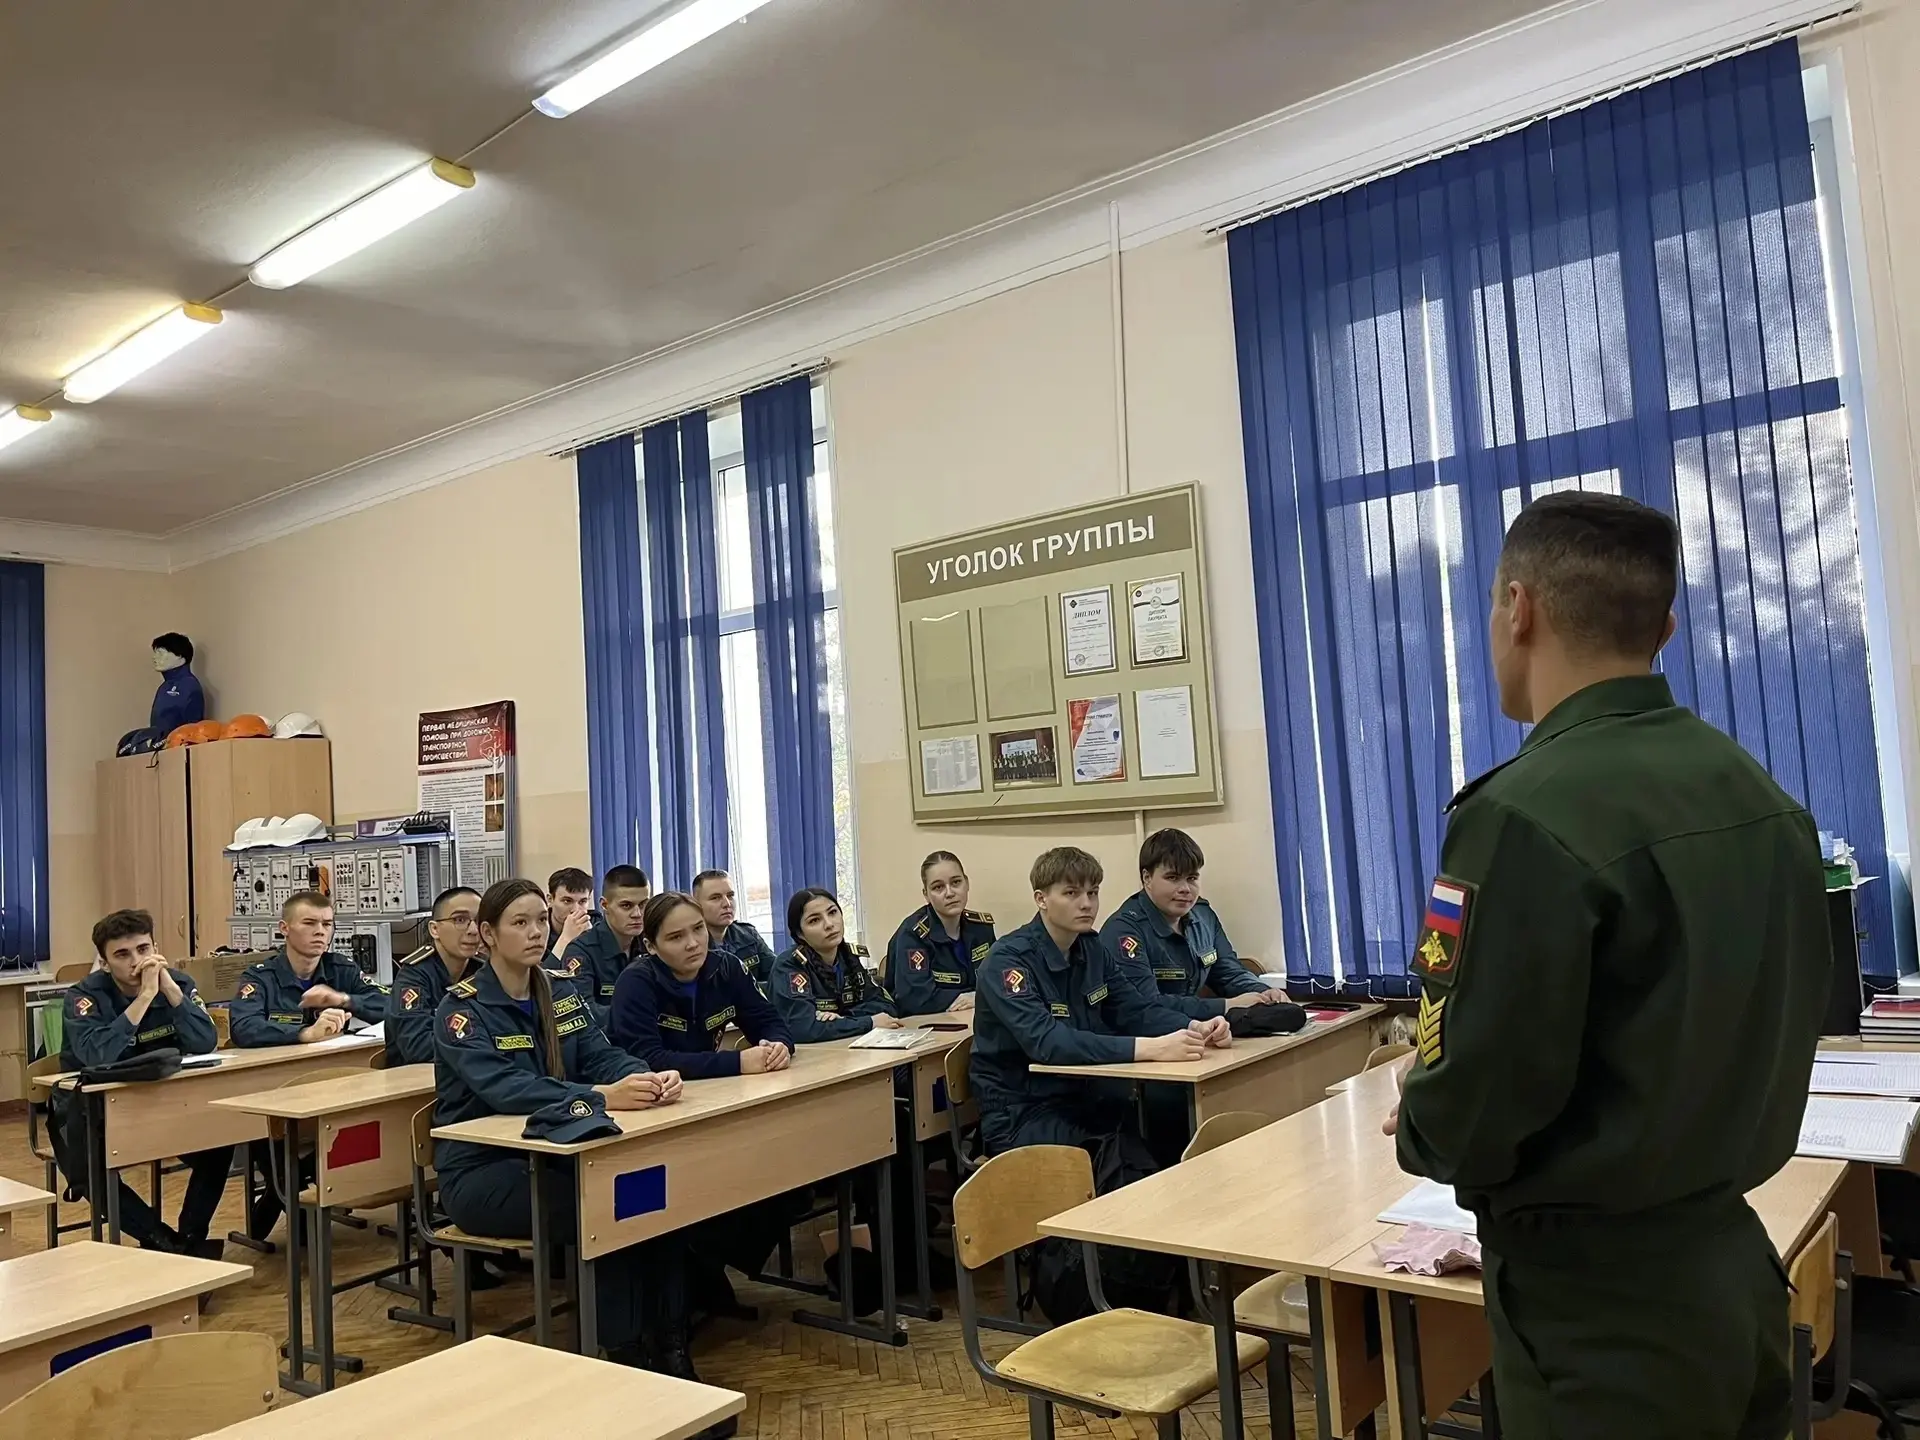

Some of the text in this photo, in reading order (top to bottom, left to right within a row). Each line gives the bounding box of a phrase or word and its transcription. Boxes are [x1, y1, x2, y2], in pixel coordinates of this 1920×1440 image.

[926, 515, 1156, 585] УГОЛОК ГРУППЫ
[1072, 608, 1102, 620] ДИПЛОМ
[421, 717, 489, 732] ПЕРВАЯ МЕДИЦИНСКАЯ
[421, 733, 449, 742] ПОМОЩЬ
[449, 731, 462, 739] ПРИ
